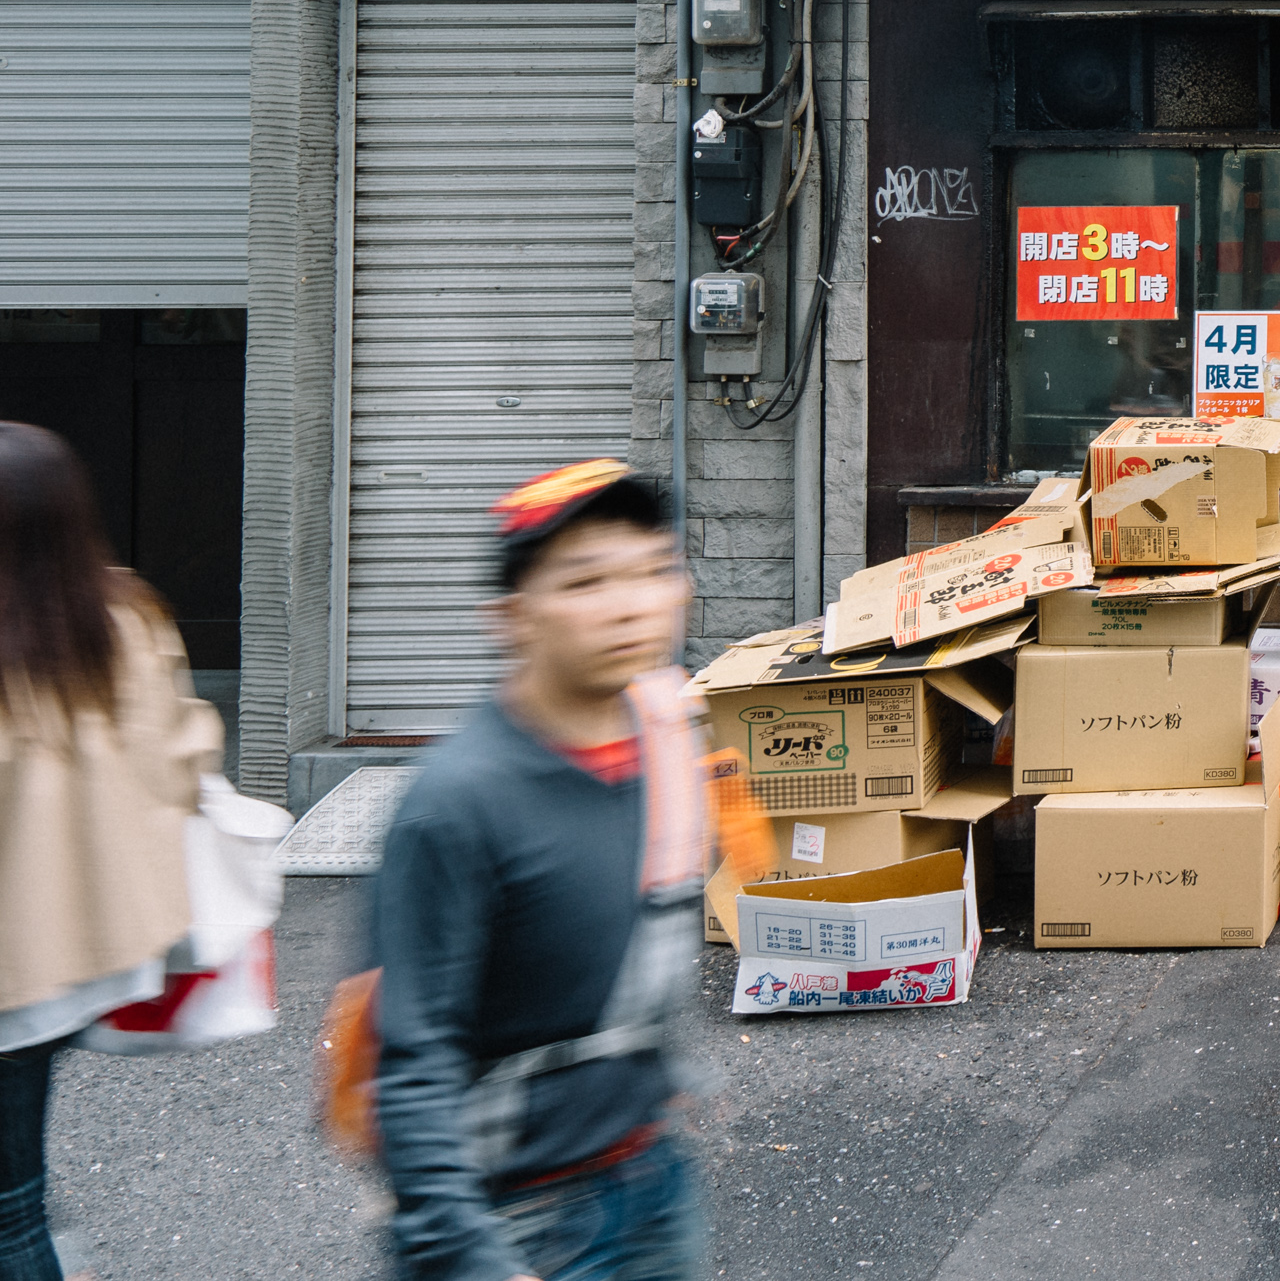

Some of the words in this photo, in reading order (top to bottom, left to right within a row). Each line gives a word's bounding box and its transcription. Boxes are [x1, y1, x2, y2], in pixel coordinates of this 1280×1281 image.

[1038, 267, 1169, 304] 閉店11時
[1204, 324, 1257, 355] 4月
[1205, 364, 1259, 390] 限定
[832, 689, 843, 697] 15
[868, 688, 911, 698] 240037
[749, 711, 774, 719] プロ用
[869, 712, 913, 722] 90枚×2ロール
[1081, 712, 1182, 732] ソフトパン粉
[883, 726, 898, 734] 6袋
[763, 734, 826, 757] リード
[789, 751, 822, 760] ペーパー
[830, 748, 845, 757] 90
[1205, 769, 1235, 779] KD380
[1097, 869, 1199, 887] ソフトパン粉
[1222, 929, 1252, 938] KD380
[789, 973, 839, 992] 八戸港
[788, 988, 922, 1007] 船内一尾凍結いか
